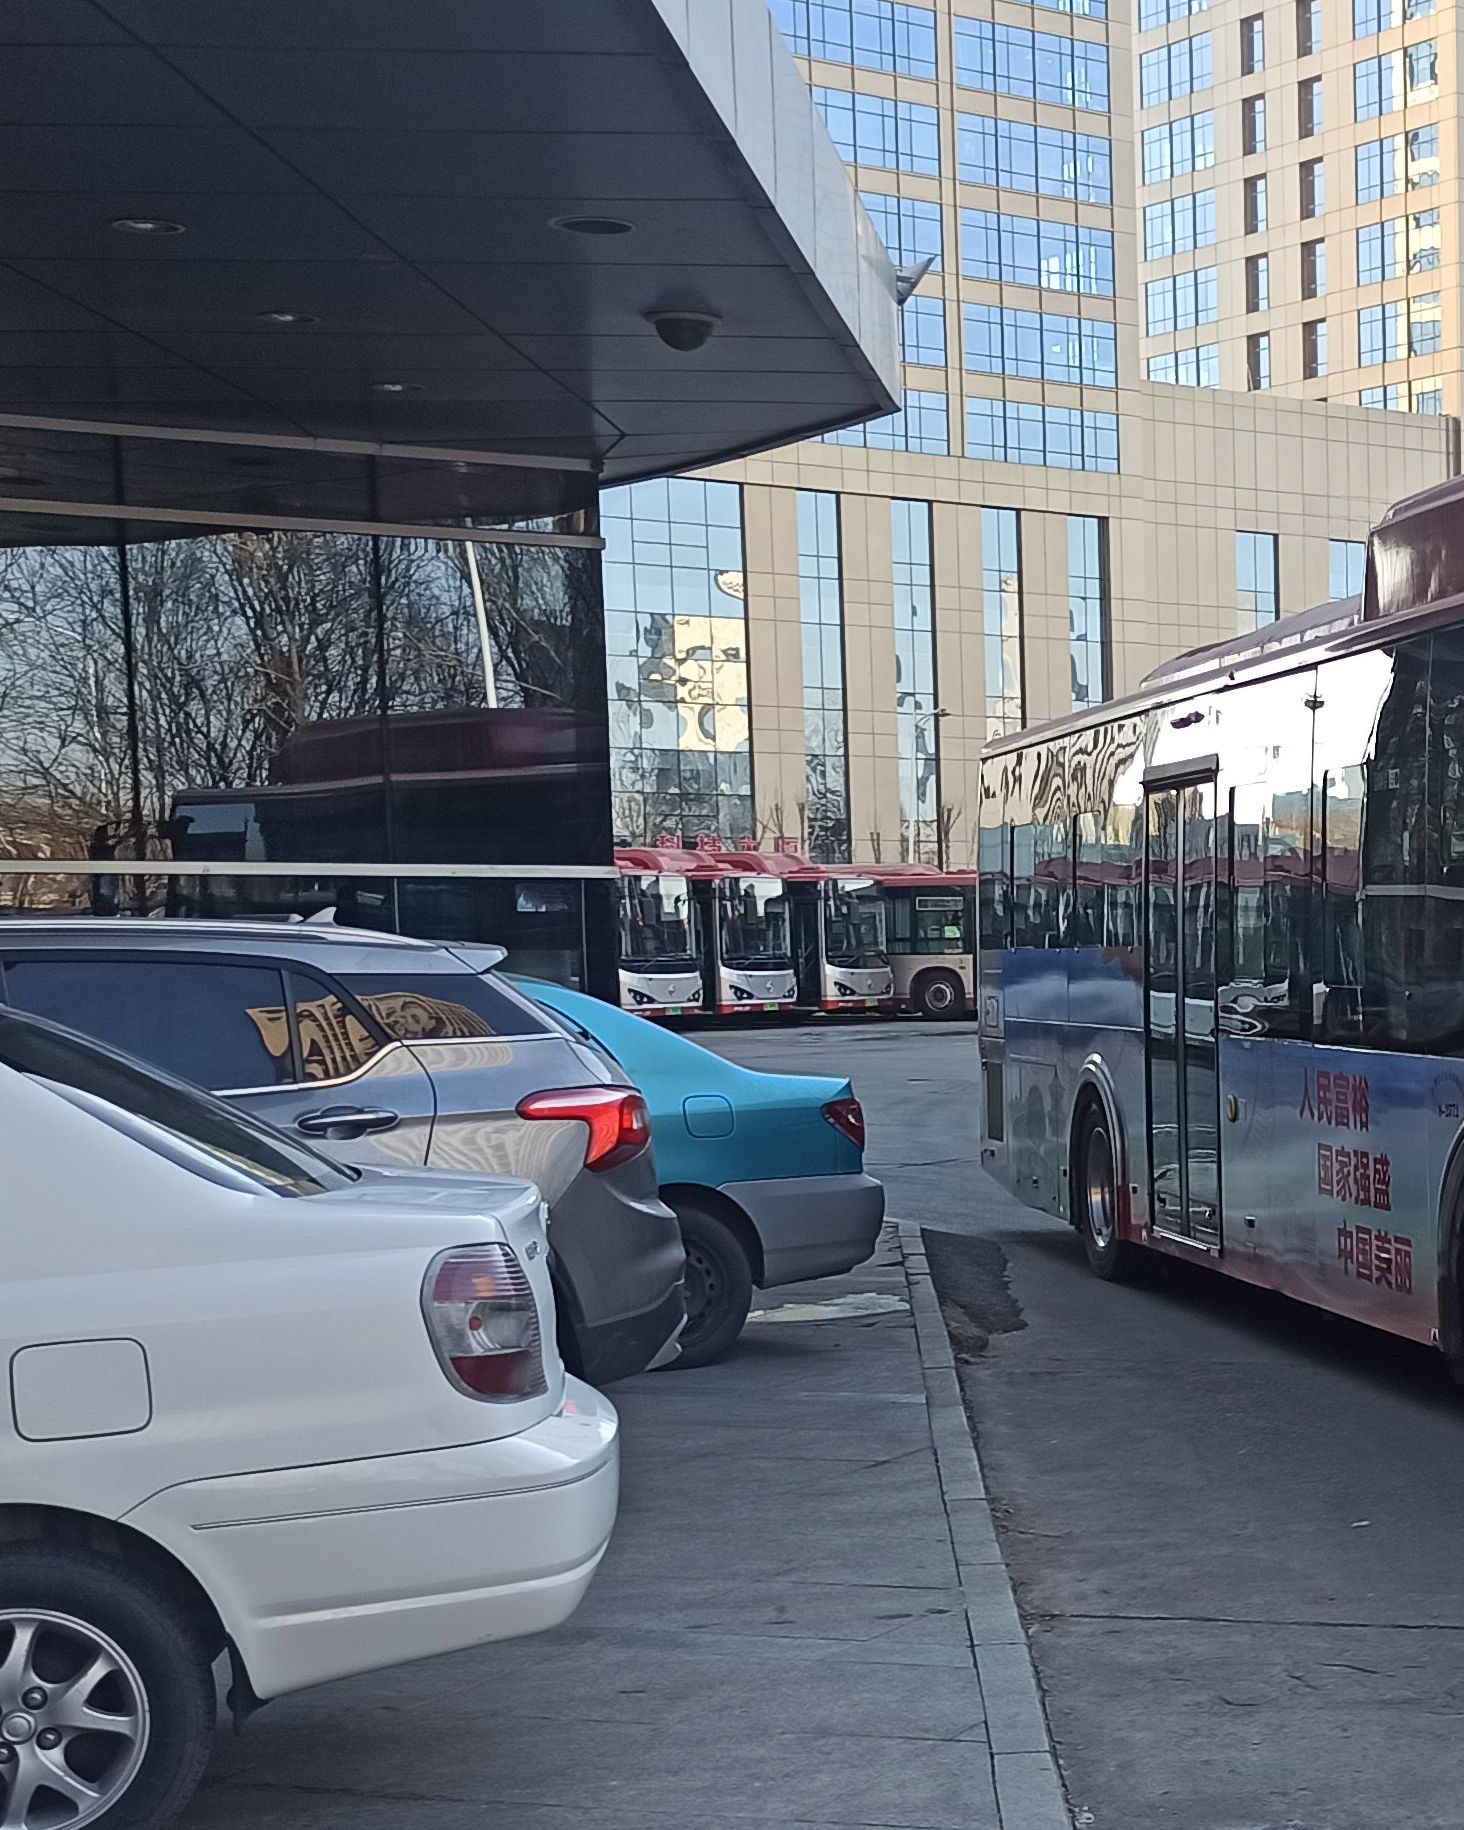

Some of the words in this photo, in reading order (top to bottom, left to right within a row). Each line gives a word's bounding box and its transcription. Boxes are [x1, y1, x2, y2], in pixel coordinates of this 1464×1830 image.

[1300, 1067, 1370, 1133] 人民富裕
[1317, 1142, 1392, 1212] 国家强盛
[1336, 1218, 1413, 1295] 中国美丽
